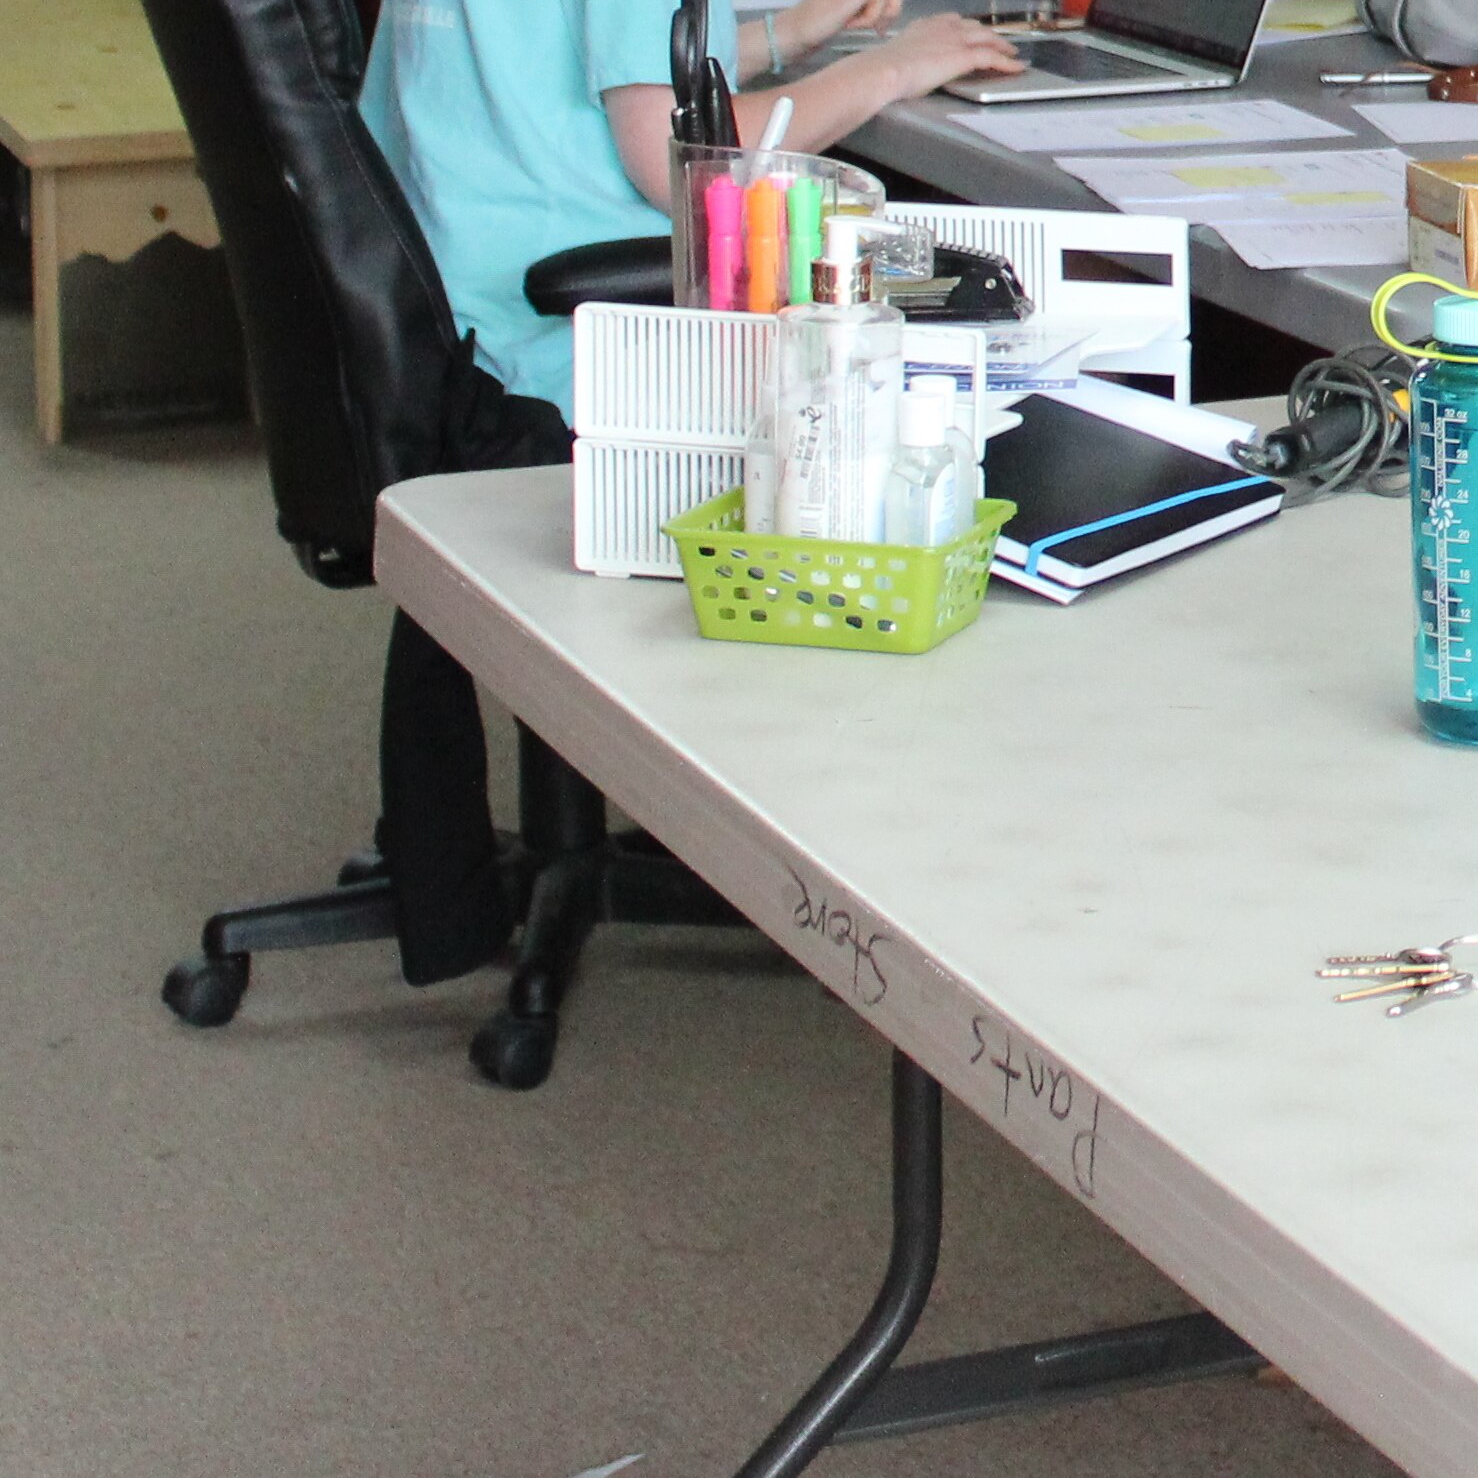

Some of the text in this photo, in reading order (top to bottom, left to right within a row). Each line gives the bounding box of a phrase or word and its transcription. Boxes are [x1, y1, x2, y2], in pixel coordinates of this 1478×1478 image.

[1457, 489, 1469, 499] 24
[1458, 530, 1470, 539] 20
[1460, 609, 1470, 618] 12
[782, 861, 1100, 1201] Pants Store
